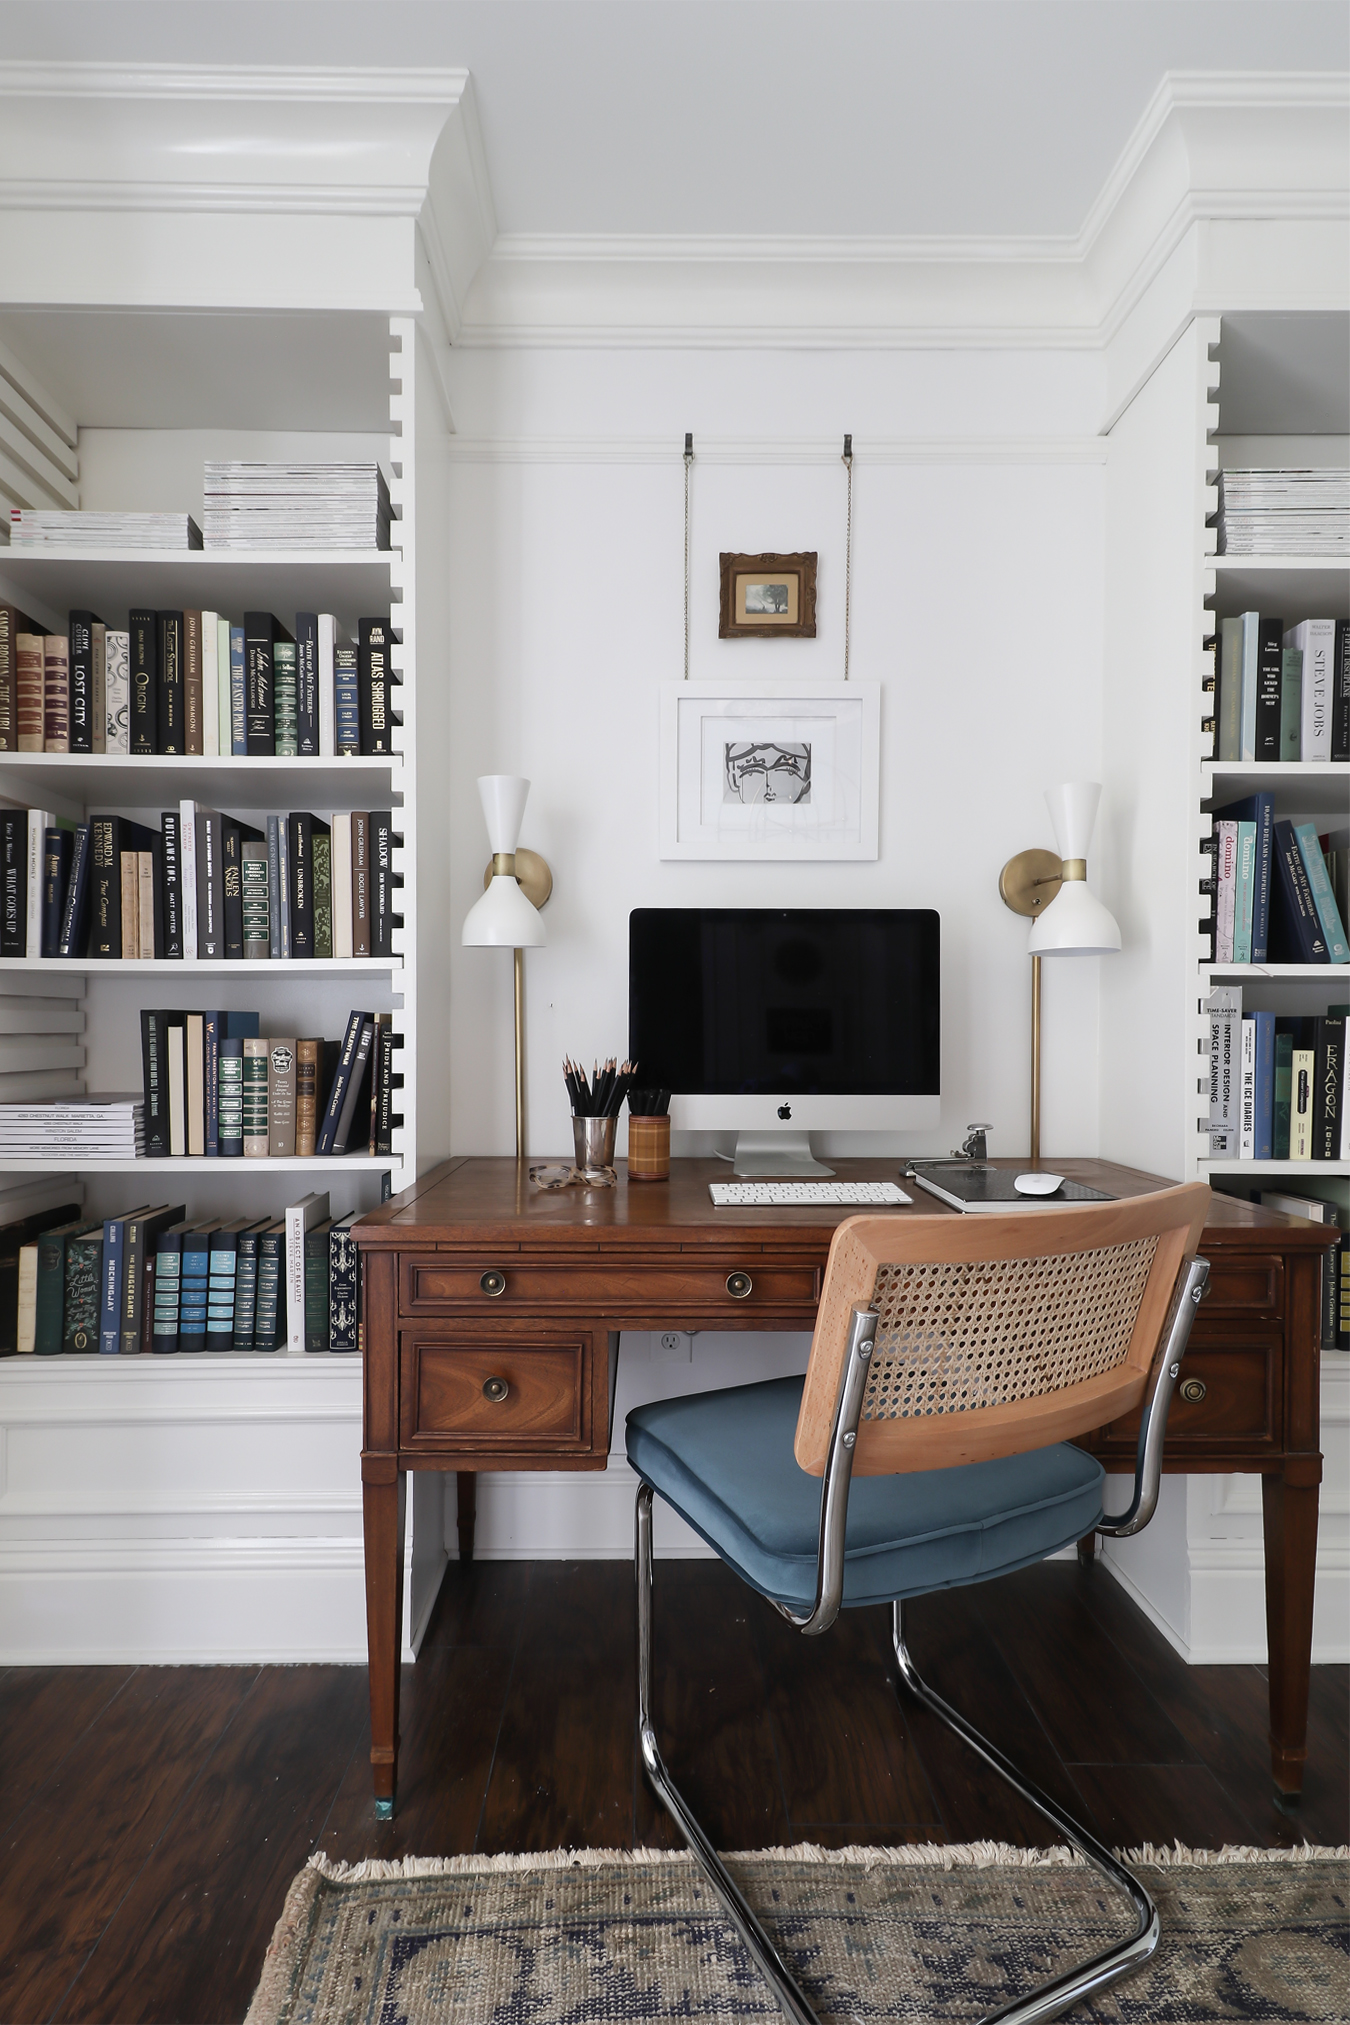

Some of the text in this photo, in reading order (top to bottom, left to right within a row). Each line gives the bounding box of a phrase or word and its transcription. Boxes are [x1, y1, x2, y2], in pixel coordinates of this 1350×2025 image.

[371, 628, 383, 636] AYN
[0, 645, 9, 677] BROWN
[167, 631, 175, 683] LOST SYMBOL
[306, 640, 314, 714] FAITH OF MY FATHERS
[1, 685, 10, 731] THE ALIBI
[74, 665, 85, 726] LOST CITY
[135, 672, 150, 713] ORIGIN
[232, 664, 245, 742] THE EASTER PARADE
[370, 652, 385, 730] ATLAS SHRUGGED
[1313, 650, 1325, 737] STEVE JOBS
[94, 823, 104, 867] KENNEDY
[104, 823, 114, 868] EDWARD M.
[165, 817, 177, 886] OUTLAWS INC.
[378, 827, 388, 869] SHADOW
[1224, 836, 1235, 879] domino
[1242, 836, 1253, 880] domino
[1285, 852, 1293, 864] JOHN
[6, 868, 17, 895] WHAT
[61, 834, 85, 943] EISENHOWER CHURCHILL
[225, 866, 233, 897] ANGELS
[232, 865, 240, 897] FALLEN
[1291, 845, 1315, 917] FAITH OF MY FATHERS
[6, 895, 17, 918] GOES
[99, 880, 109, 927] True Compass
[6, 920, 17, 933] UP
[342, 1016, 359, 1066] THE SILENT WAR
[1210, 1024, 1220, 1103] SPACE PLANNING
[1324, 1044, 1338, 1119] ERAGON
[1223, 1069, 1231, 1102] DESIGN
[1243, 1072, 1253, 1132] THE ICE DIARIES
[330, 1099, 339, 1117] Craven
[382, 1088, 390, 1130] PREJUDICE
[295, 1218, 300, 1228] AN
[69, 1275, 95, 1287] Little
[296, 1261, 301, 1271] OF
[1327, 1249, 1335, 1274] Lawyer
[66, 1285, 98, 1298] Women
[107, 1260, 116, 1312] MOCKINGJAY
